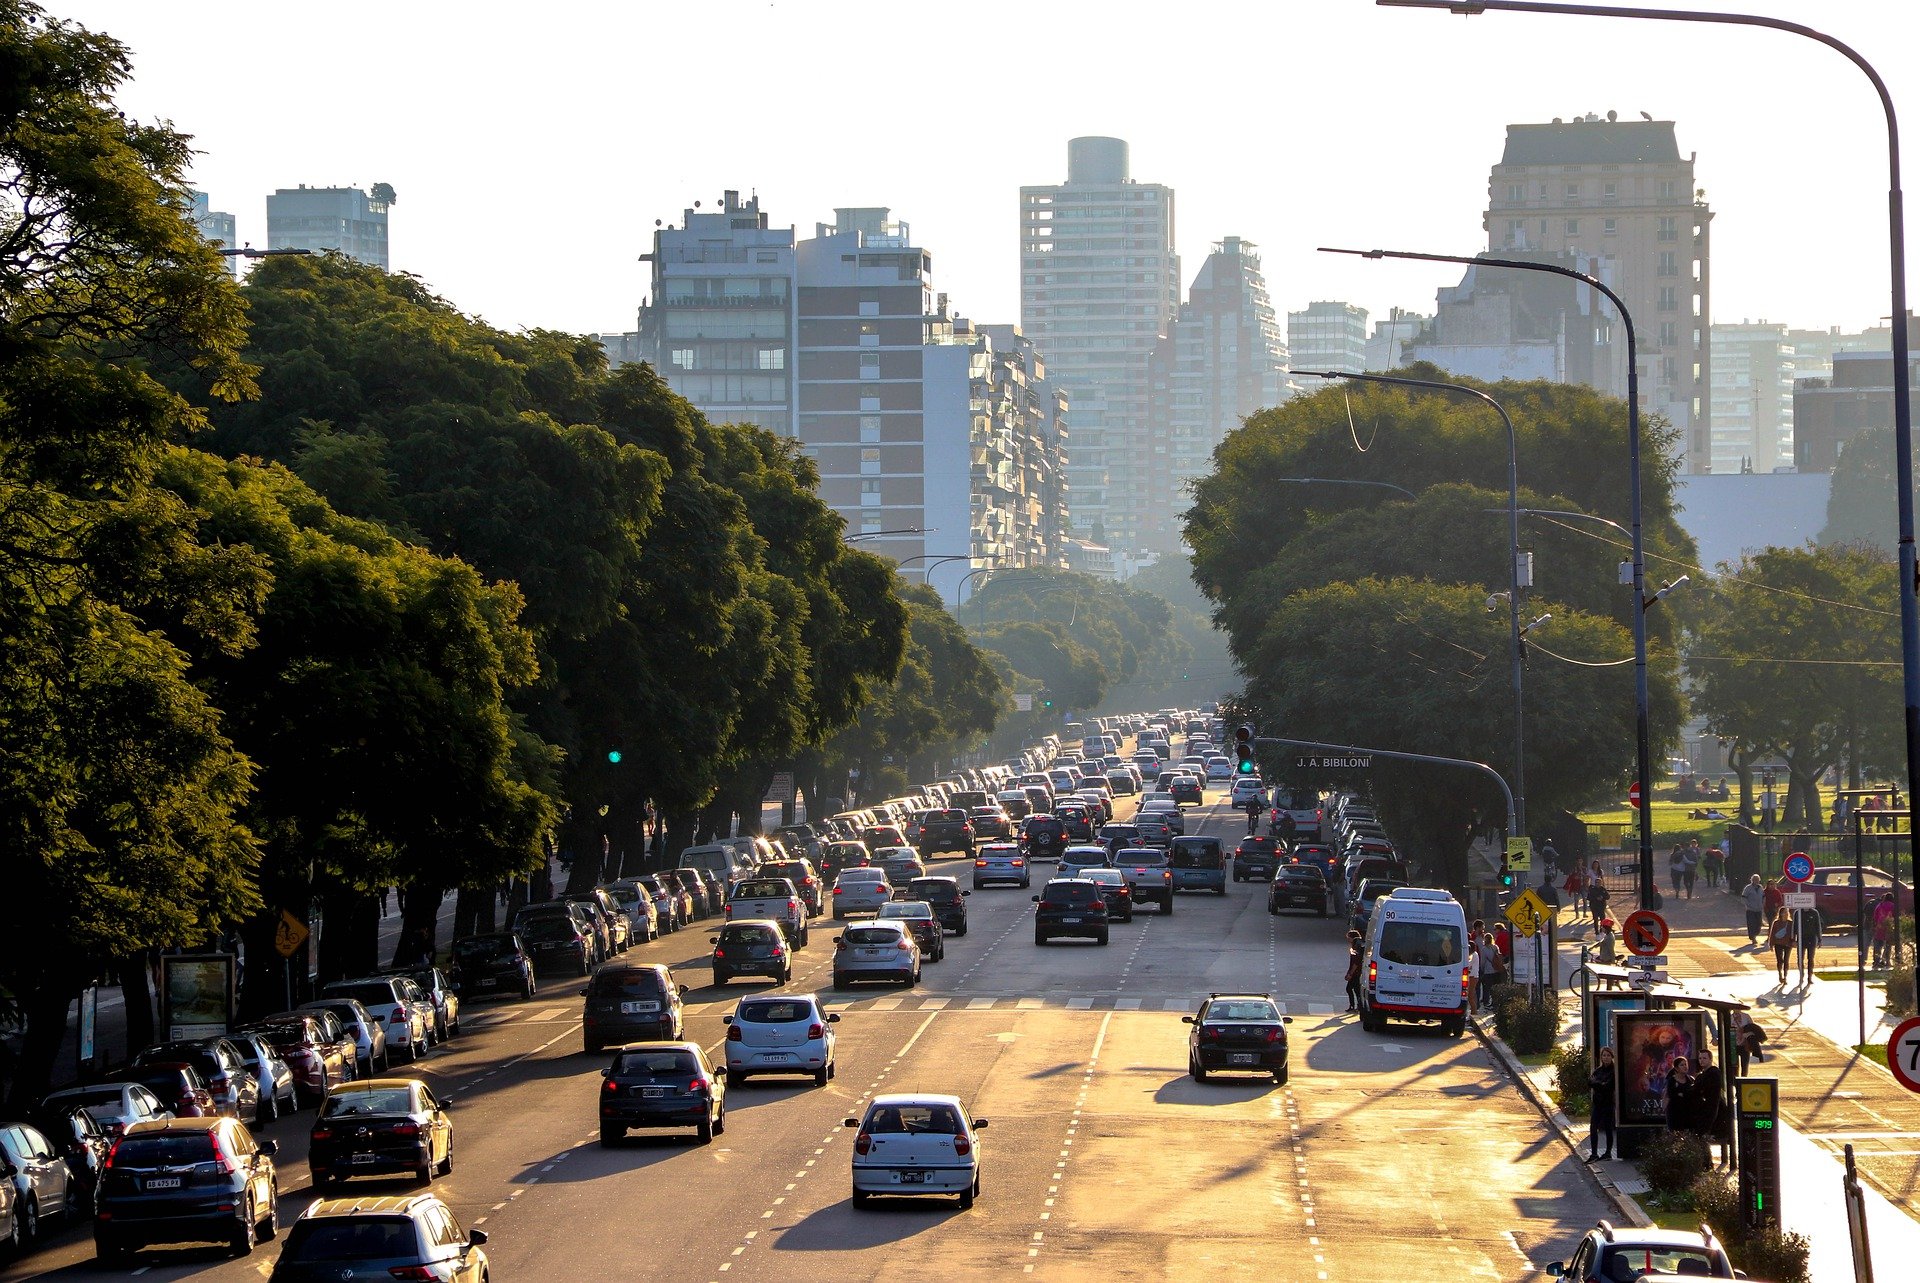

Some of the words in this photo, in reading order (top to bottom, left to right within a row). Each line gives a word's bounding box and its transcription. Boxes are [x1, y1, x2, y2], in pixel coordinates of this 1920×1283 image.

[1297, 758, 1306, 768] J.
[1309, 758, 1320, 768] A.
[1323, 758, 1369, 768] BIBILONI
[1385, 911, 1396, 920] 90
